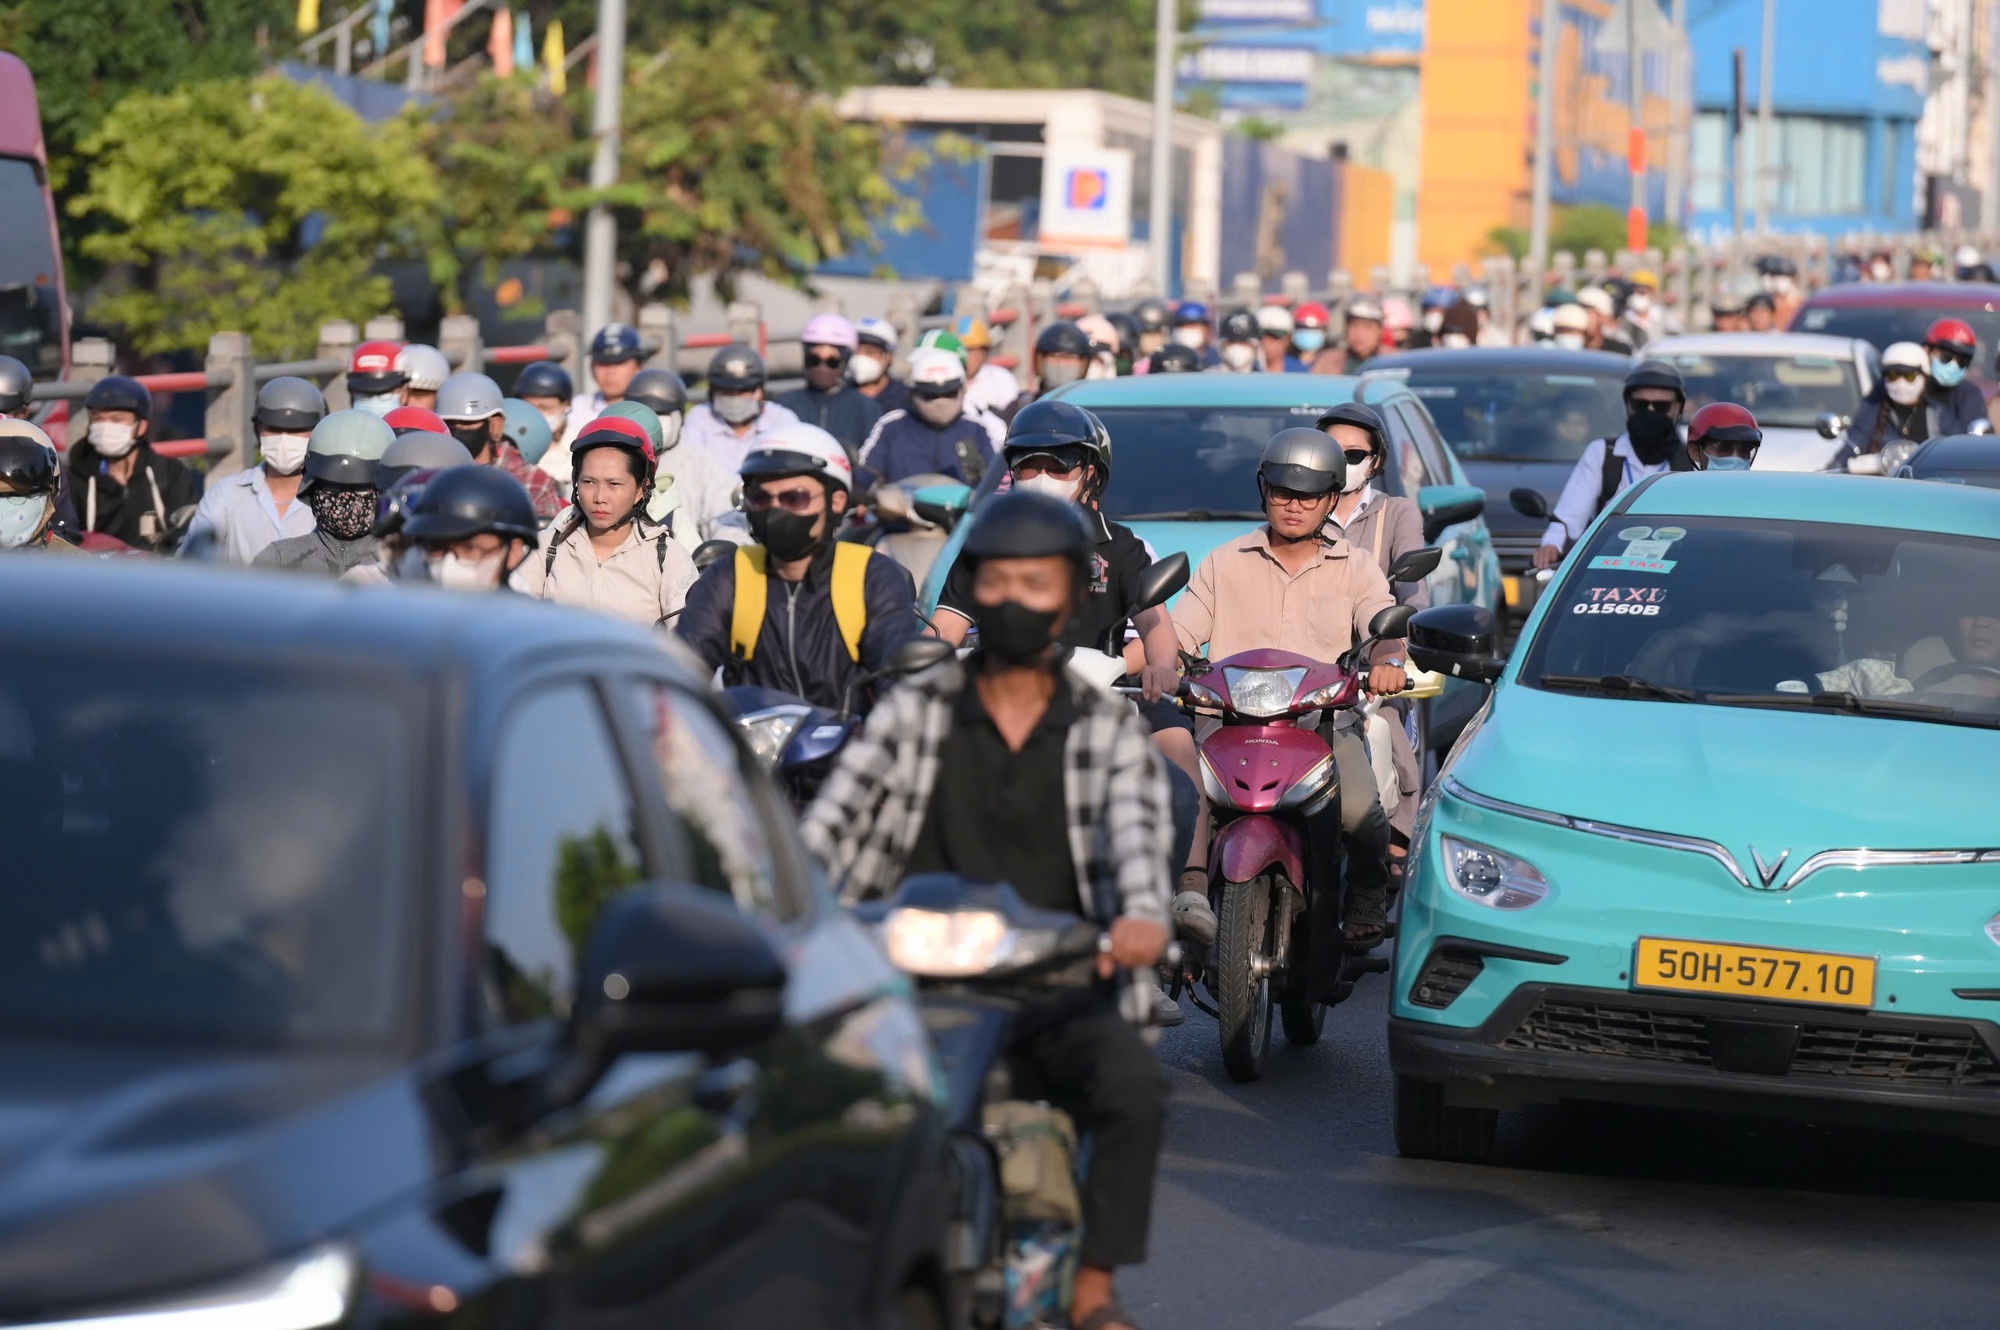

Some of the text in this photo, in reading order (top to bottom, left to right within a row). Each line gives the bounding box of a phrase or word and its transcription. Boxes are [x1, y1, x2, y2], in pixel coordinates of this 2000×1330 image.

[1601, 559, 1665, 570] XE TAXI
[1591, 587, 1661, 602] TAXI
[1245, 738, 1280, 746] HONDA
[1658, 948, 1855, 996] 50H-577.10
